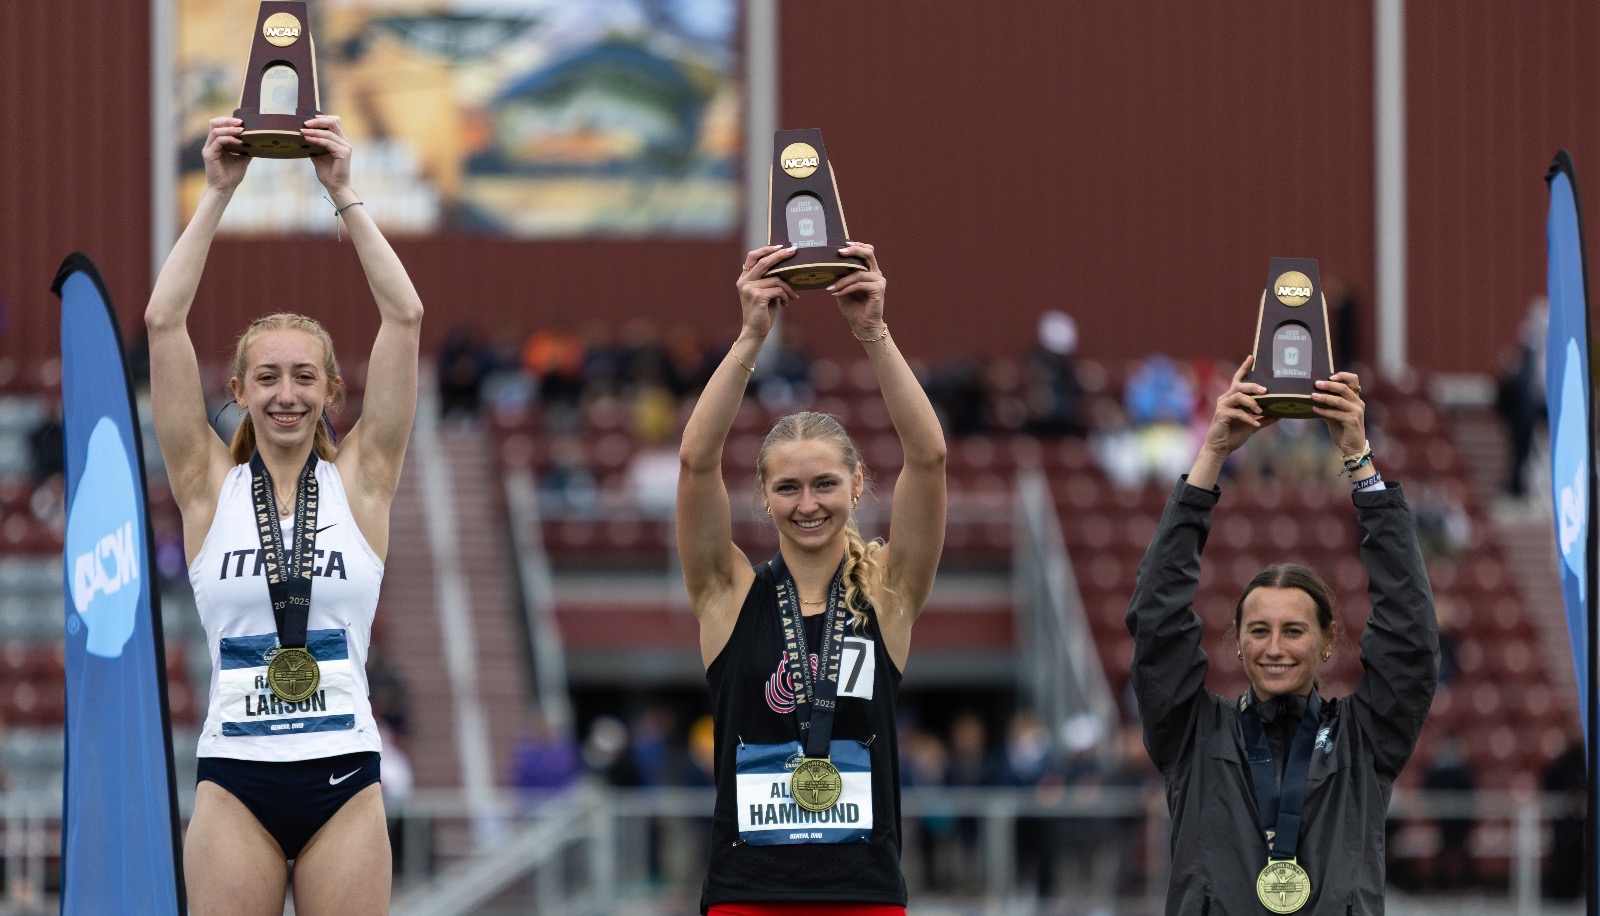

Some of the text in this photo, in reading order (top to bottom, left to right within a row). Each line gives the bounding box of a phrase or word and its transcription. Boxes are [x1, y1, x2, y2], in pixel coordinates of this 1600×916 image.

[266, 27, 299, 37] NCAA
[784, 157, 818, 169] NCAA
[1277, 286, 1311, 297] NCAA
[296, 498, 305, 527] OUTDOOR
[253, 475, 280, 584] ALL-AMERICAN
[268, 510, 282, 541] OUTDOOR
[301, 470, 317, 580] ALL-AMERICAN
[275, 540, 285, 560] TRACK
[293, 533, 302, 560] DIVISION
[279, 565, 288, 582] FIELD
[292, 560, 301, 579] NCAA
[274, 600, 287, 610] 20
[289, 597, 310, 606] 2025
[789, 594, 800, 621] DIVISION
[826, 597, 836, 629] OUTDOOR
[776, 585, 806, 704] ALL-AMERICAN
[796, 627, 807, 660] OUTDOOR
[821, 634, 831, 661] DIVISION
[802, 659, 811, 680] TRACK
[819, 662, 827, 681] NCAA
[245, 690, 327, 716] LARSON
[806, 685, 814, 702] FIELD
[815, 699, 836, 708] 2025
[800, 722, 811, 730] 20
[750, 803, 860, 826] HAMMOND
